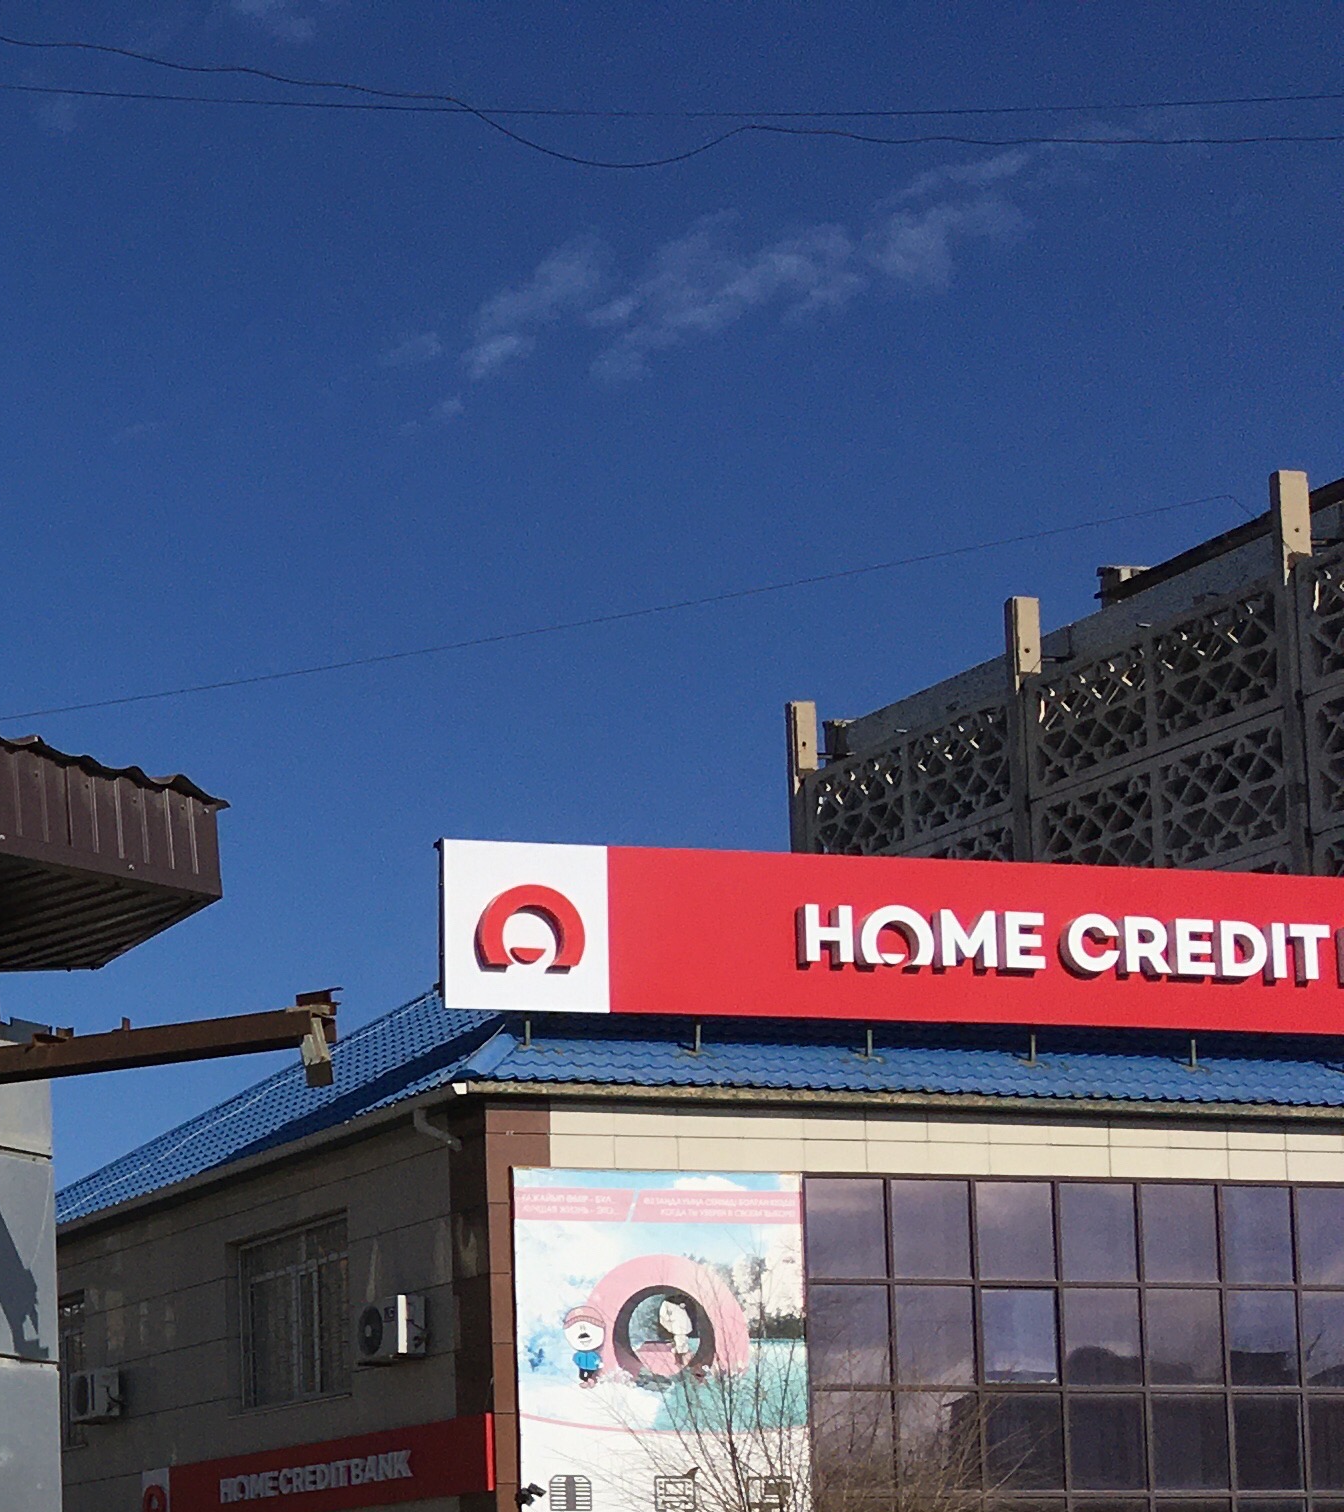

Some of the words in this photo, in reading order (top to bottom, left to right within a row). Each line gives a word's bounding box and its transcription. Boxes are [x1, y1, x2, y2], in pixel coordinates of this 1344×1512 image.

[799, 903, 1047, 971] HOME
[1063, 912, 1331, 982] CREDIT
[219, 1470, 279, 1504] HOME
[279, 1459, 349, 1495] CREDIT
[349, 1449, 414, 1486] BANK
